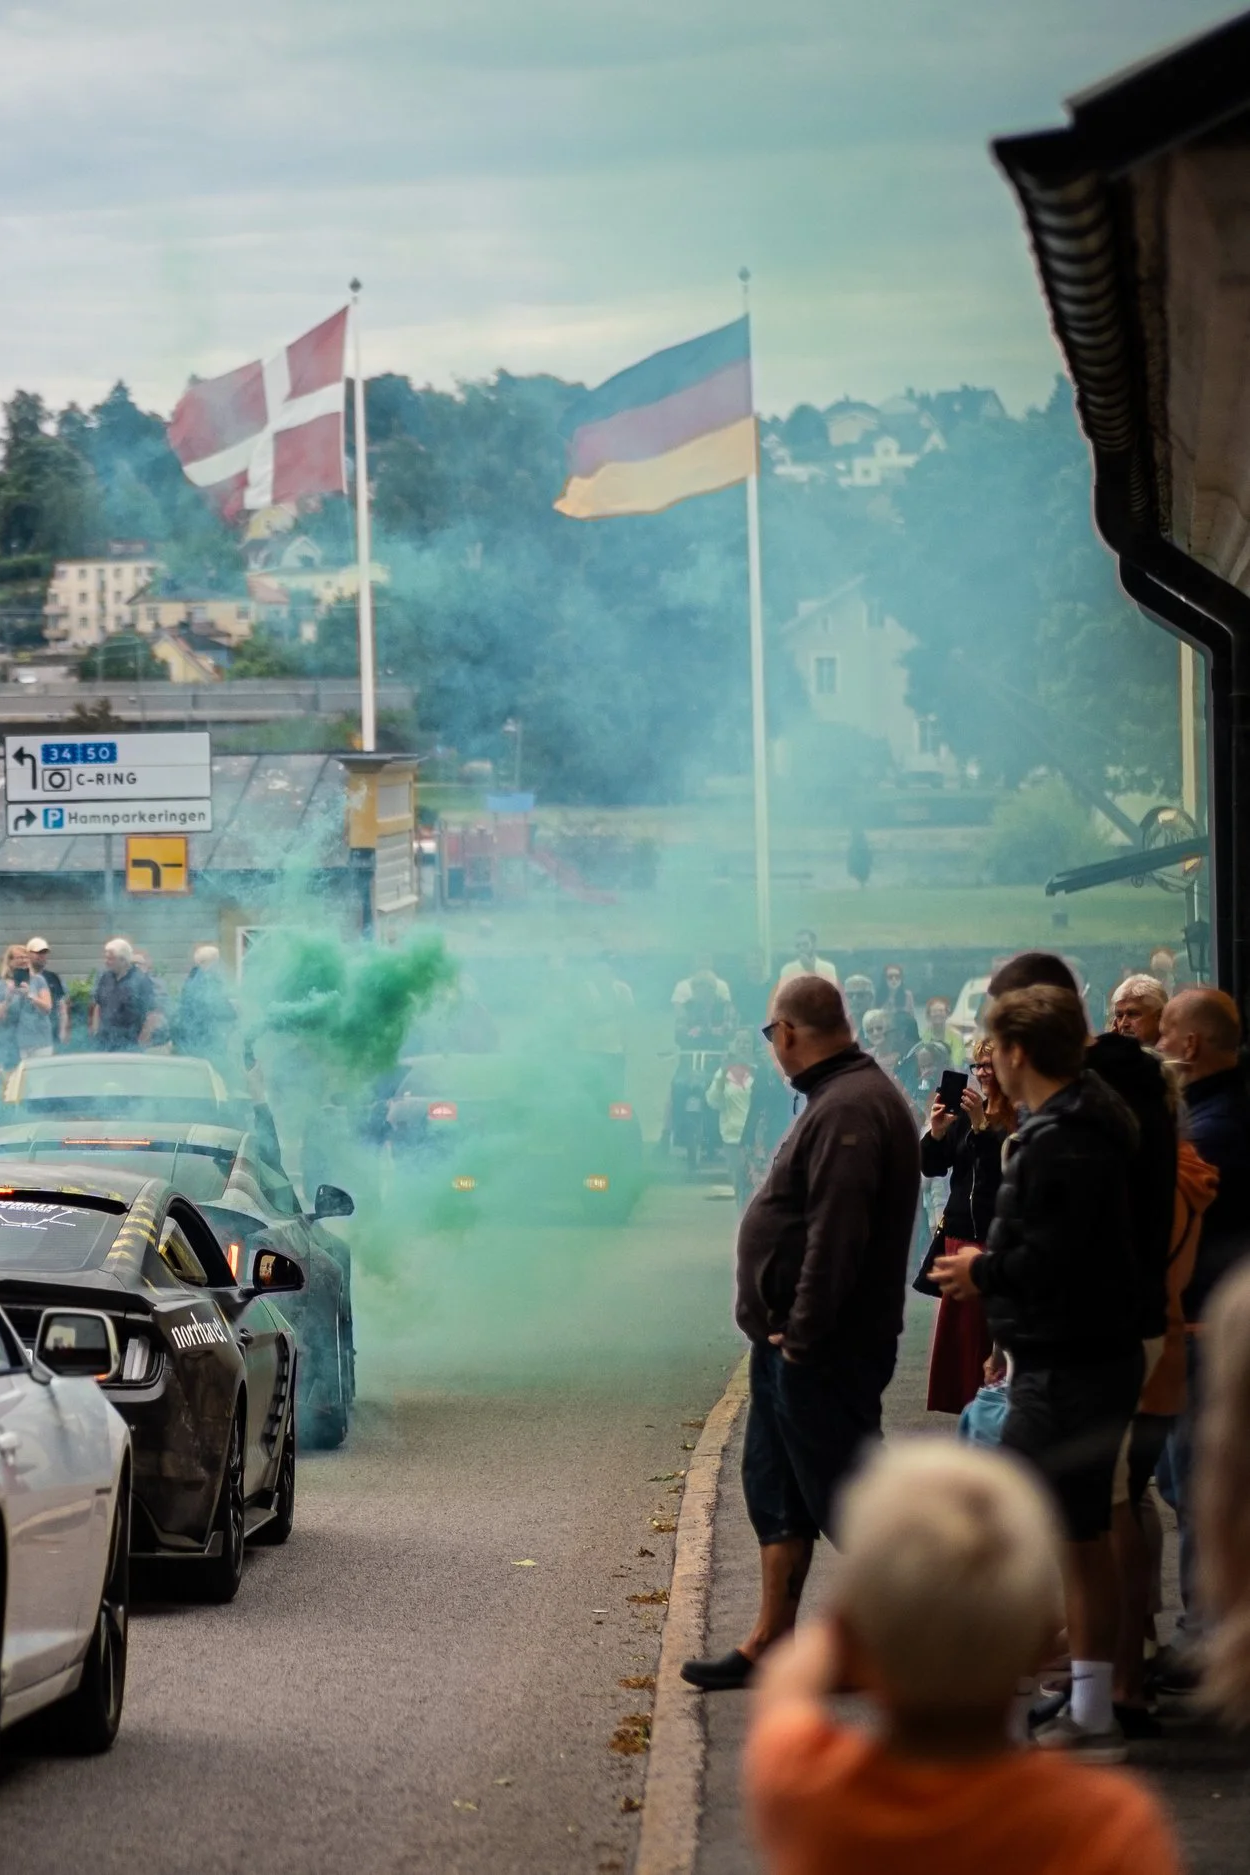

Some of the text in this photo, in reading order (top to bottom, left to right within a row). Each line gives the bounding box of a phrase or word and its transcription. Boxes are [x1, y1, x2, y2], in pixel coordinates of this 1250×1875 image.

[50, 746, 110, 761] 34 50
[76, 773, 137, 786] C-RING
[47, 809, 206, 828] P Hamnparkeringen
